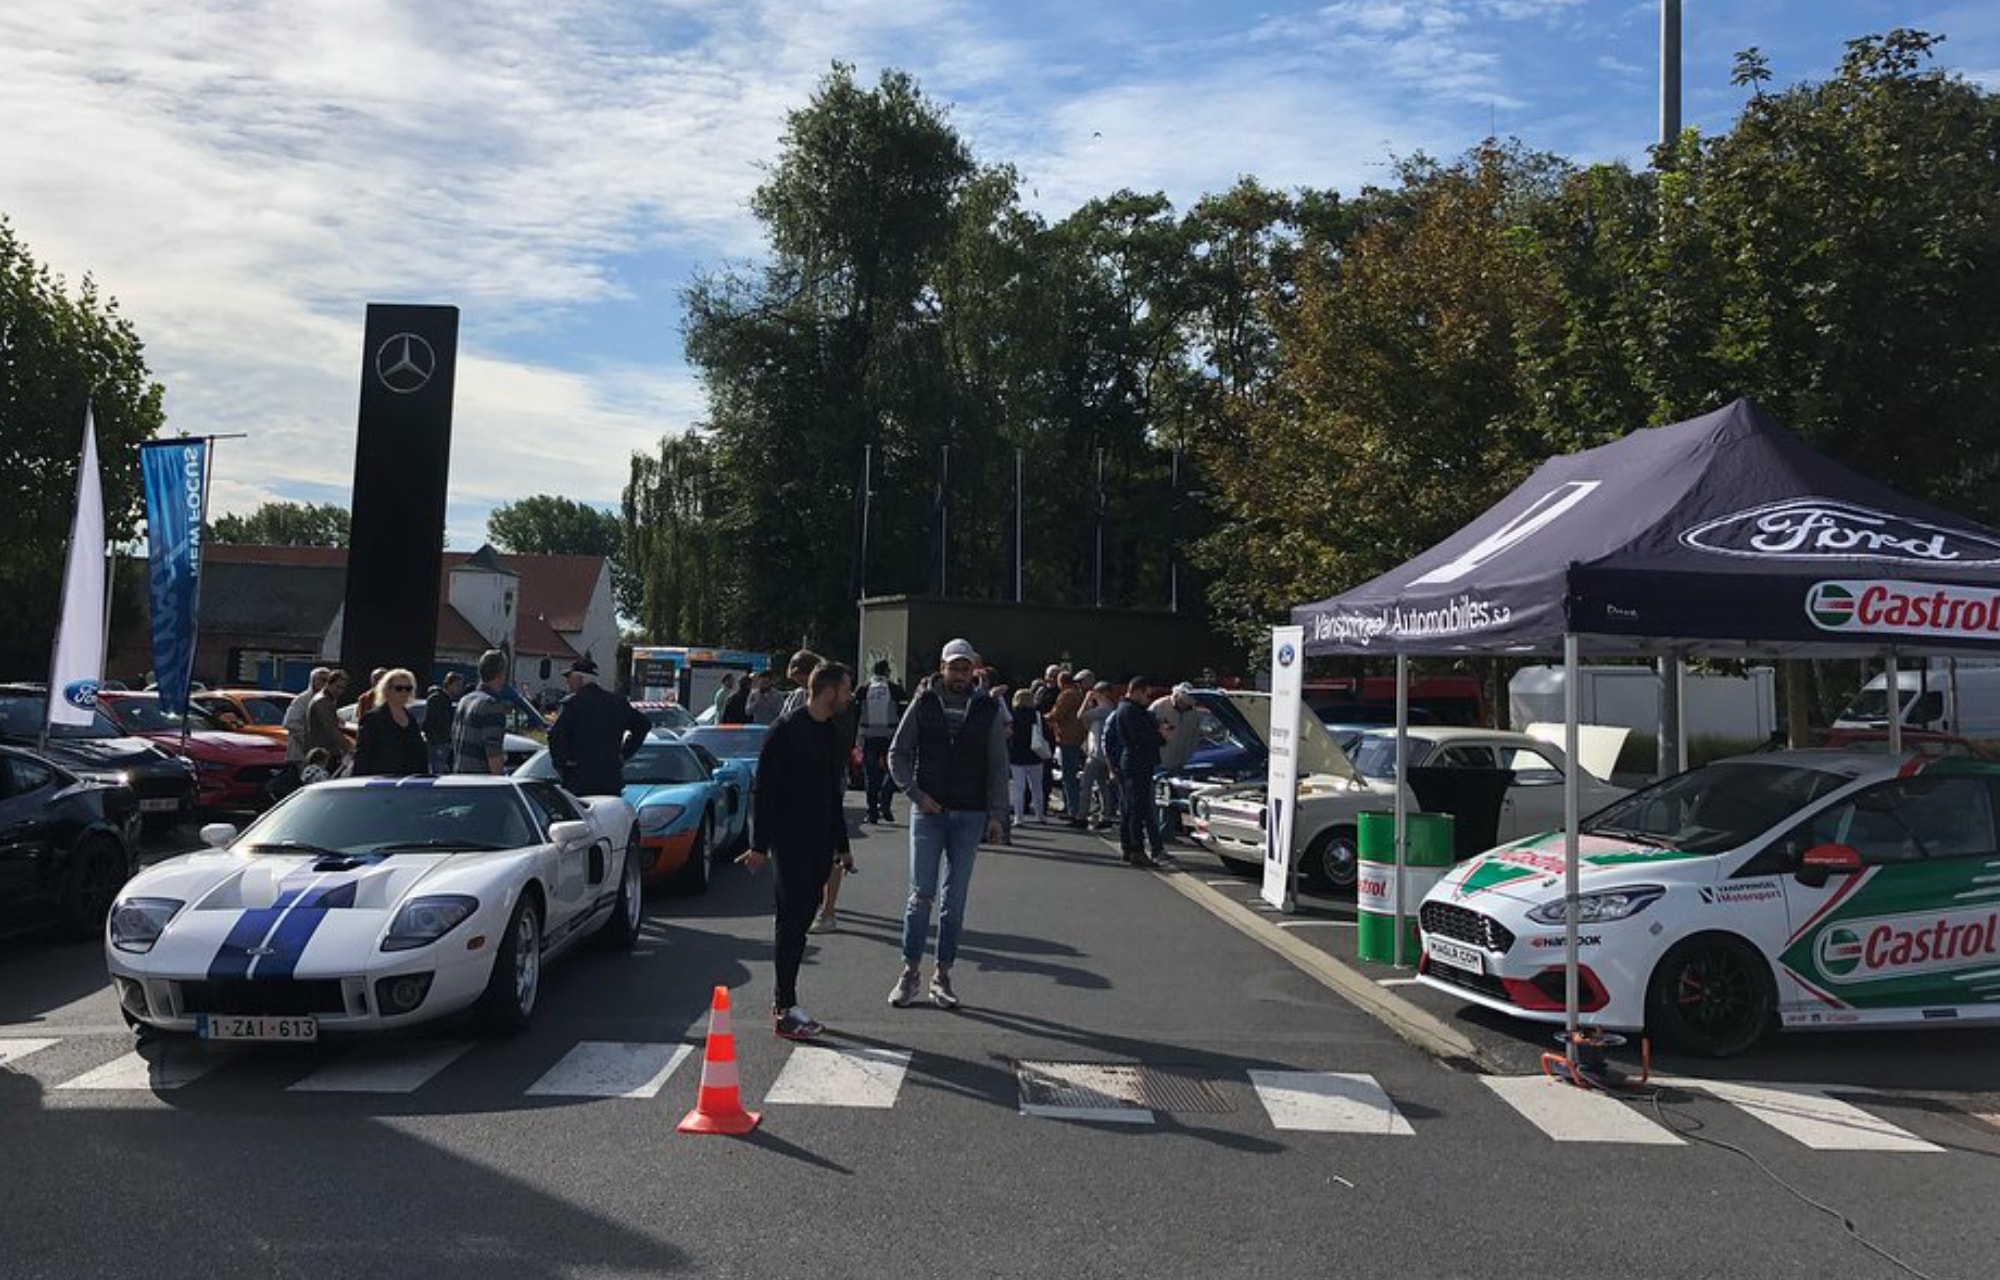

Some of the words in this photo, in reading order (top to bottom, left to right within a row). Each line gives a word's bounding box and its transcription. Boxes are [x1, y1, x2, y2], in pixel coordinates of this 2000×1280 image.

[1750, 508, 1960, 559] Ford
[1392, 595, 1489, 636] Automobiles
[1858, 586, 2000, 632] Castrol
[1865, 914, 1998, 969] Castrol
